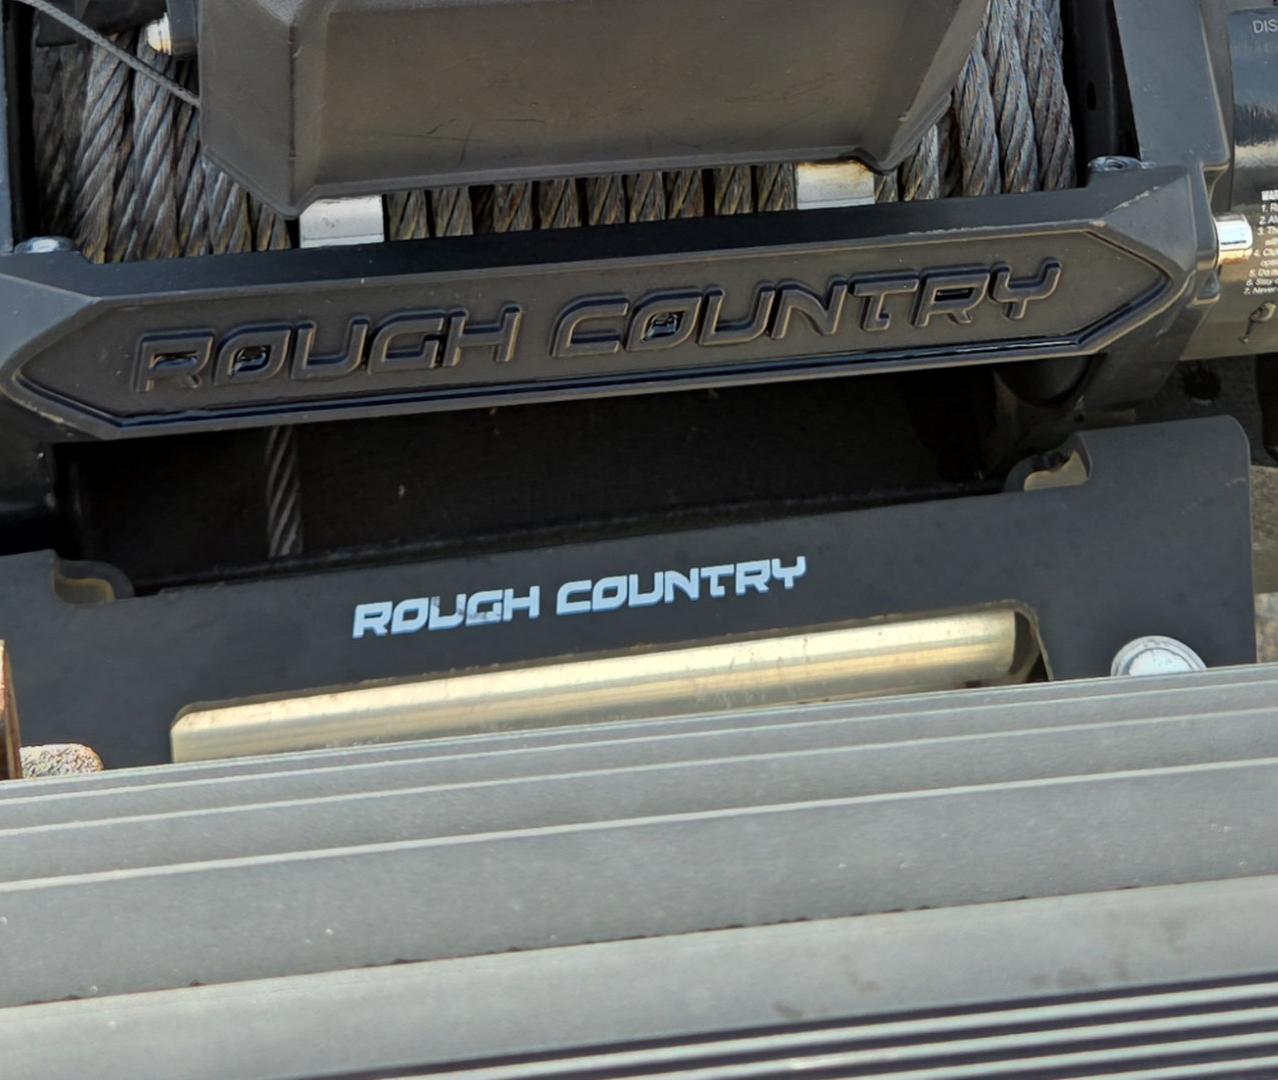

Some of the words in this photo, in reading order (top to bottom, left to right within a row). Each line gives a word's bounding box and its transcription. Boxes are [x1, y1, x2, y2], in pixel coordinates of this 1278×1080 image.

[135, 300, 521, 395] ROUGH
[549, 256, 1064, 360] COUNTRY
[353, 586, 541, 639] ROUGH
[555, 556, 807, 616] COUNTRY
